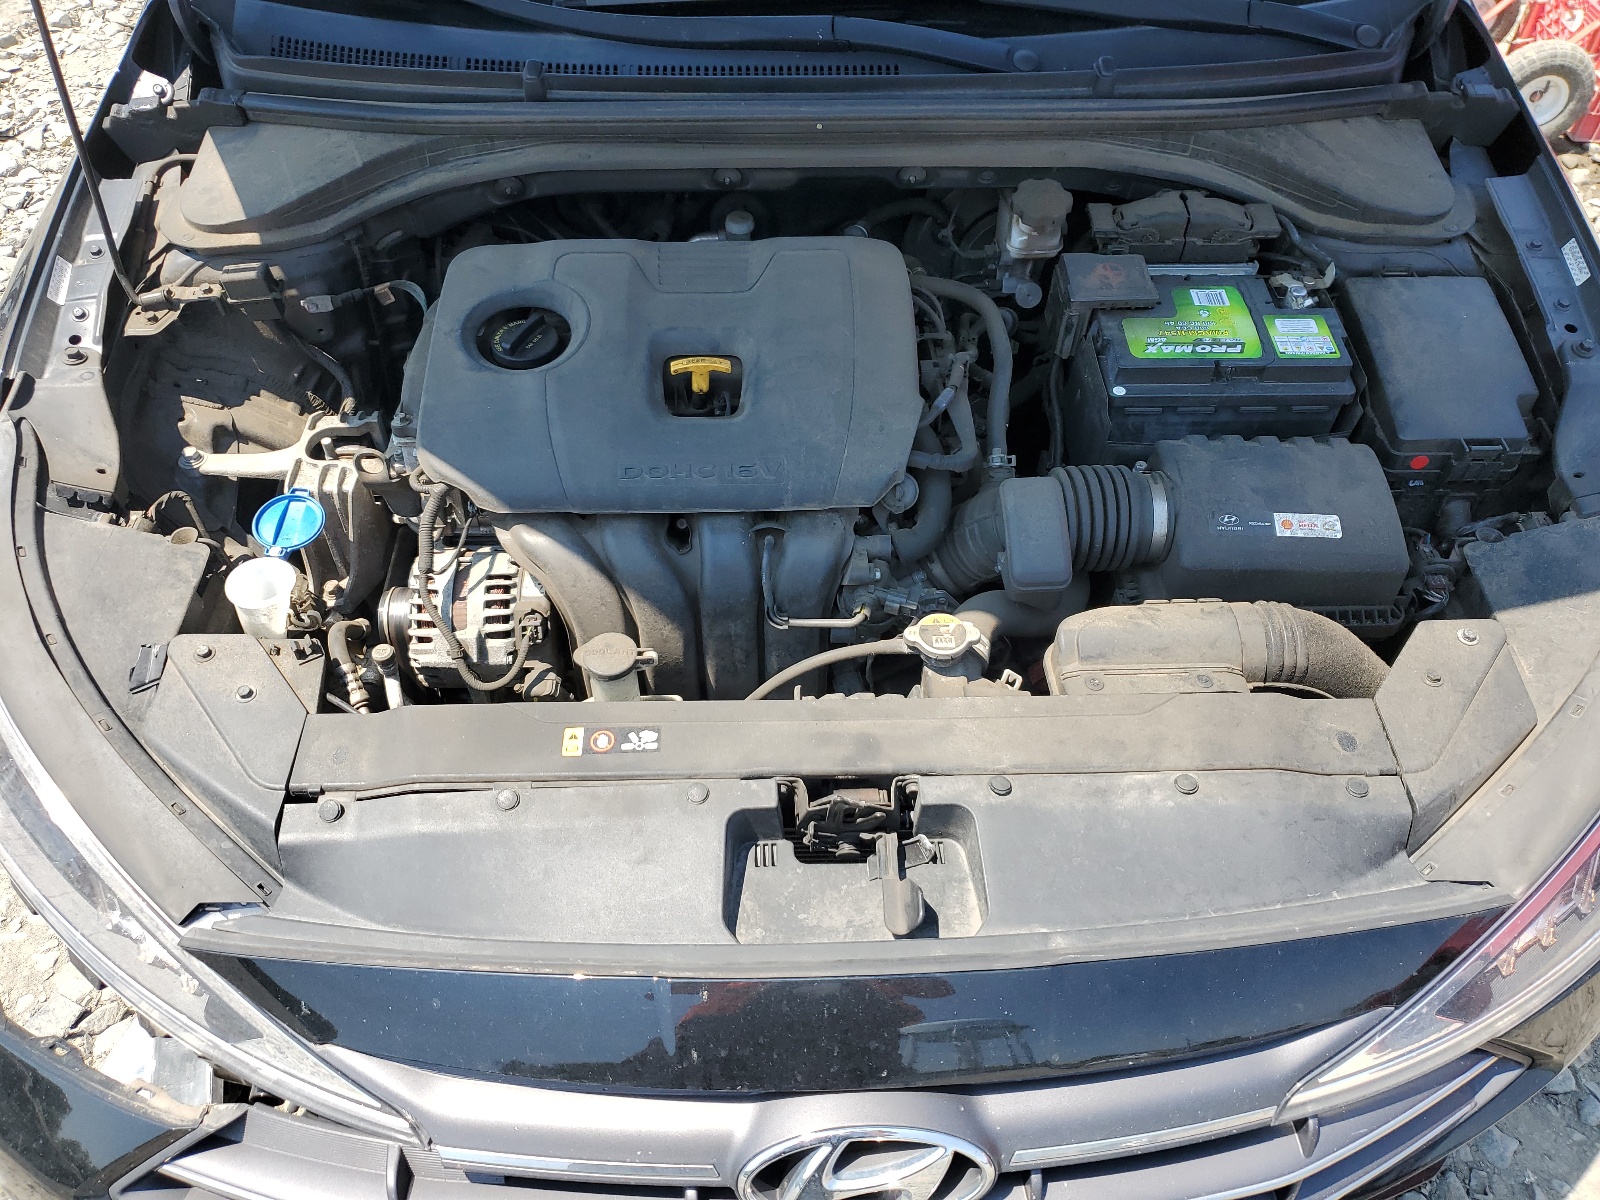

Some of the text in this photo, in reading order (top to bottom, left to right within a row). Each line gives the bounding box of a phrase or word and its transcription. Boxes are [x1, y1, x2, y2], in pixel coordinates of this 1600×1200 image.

[620, 462, 785, 480] DOHC 16V
[585, 647, 635, 657] COOLANT
